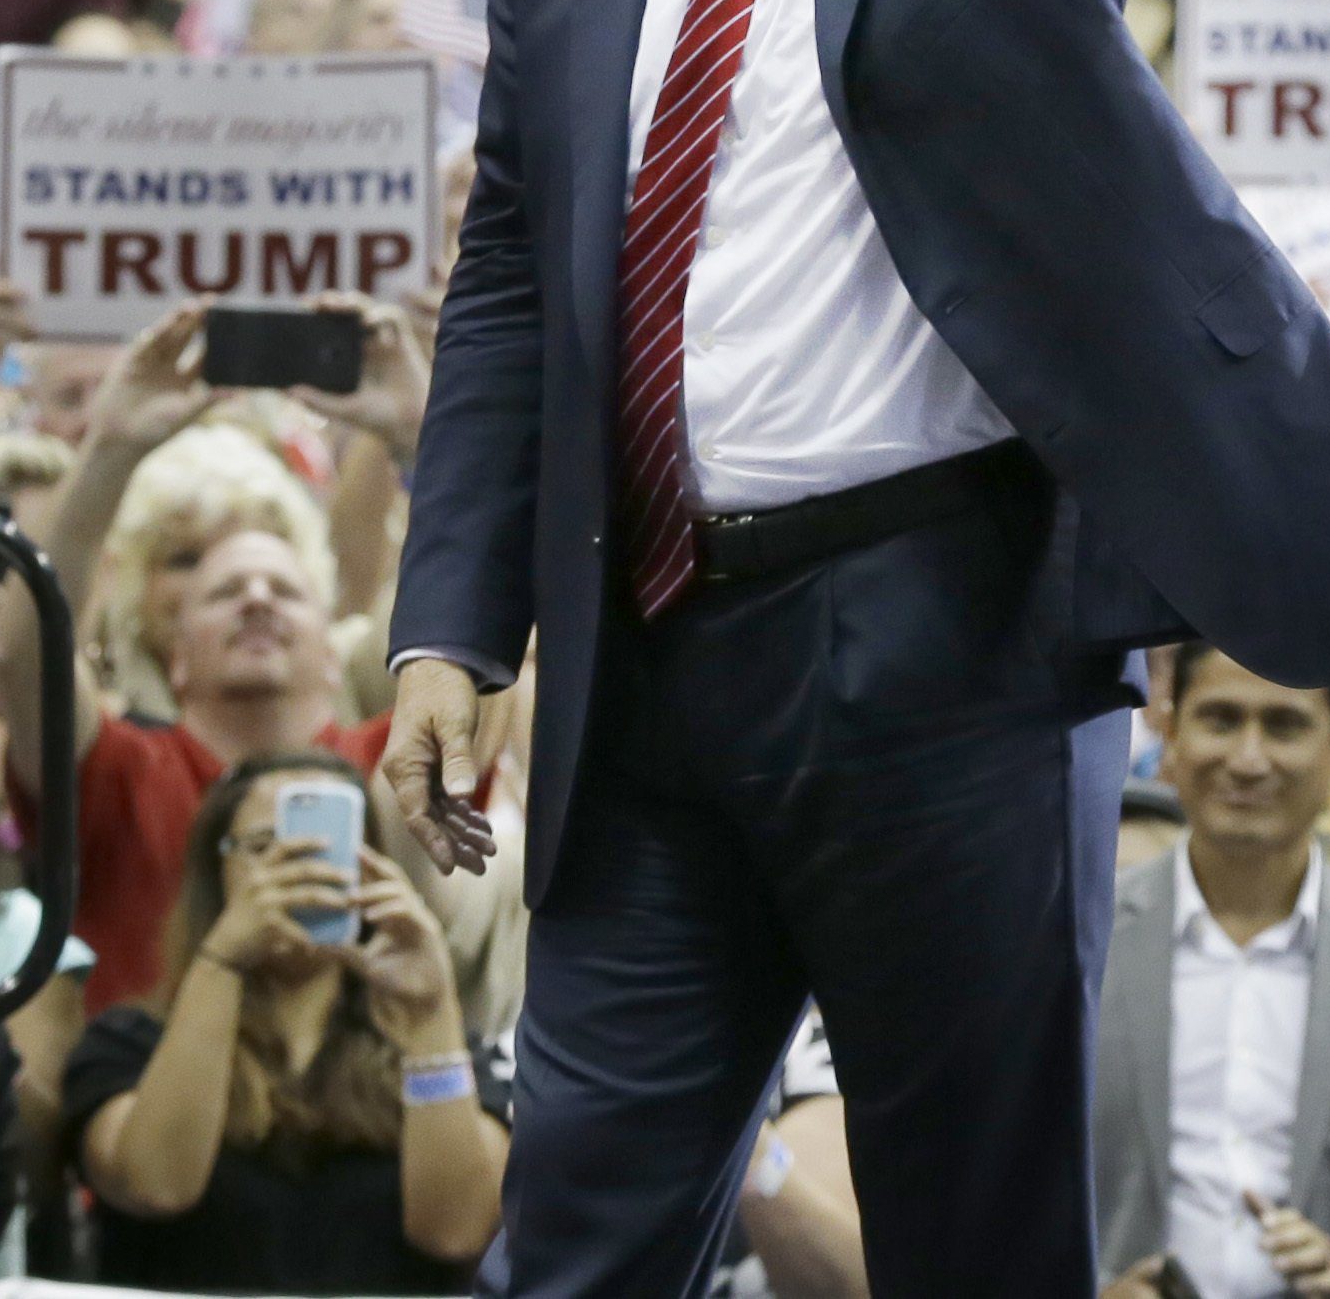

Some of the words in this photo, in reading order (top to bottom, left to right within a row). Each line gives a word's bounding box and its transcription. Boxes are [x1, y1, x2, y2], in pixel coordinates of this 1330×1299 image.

[21, 97, 91, 142] the
[101, 102, 220, 145] silent
[226, 111, 406, 161] majority
[23, 165, 249, 205] STANDS
[267, 165, 417, 205] WITH
[23, 227, 414, 297] TRUMP
